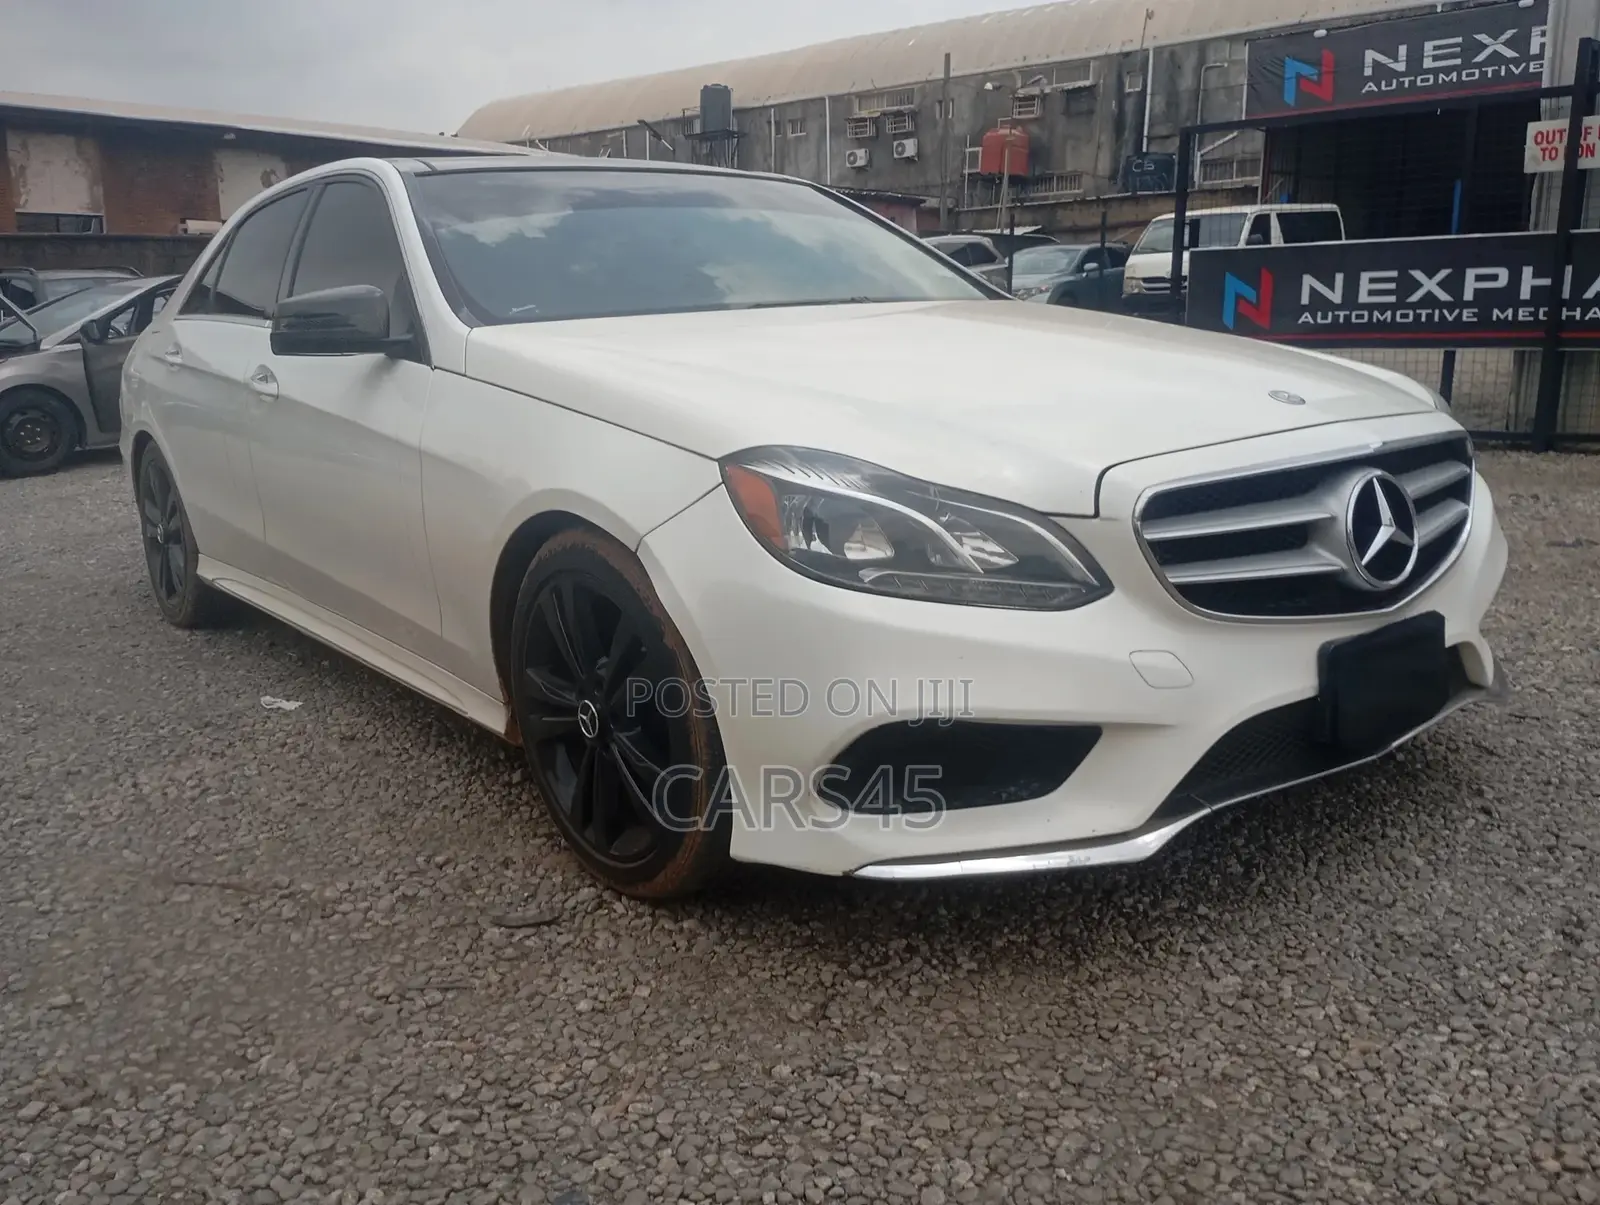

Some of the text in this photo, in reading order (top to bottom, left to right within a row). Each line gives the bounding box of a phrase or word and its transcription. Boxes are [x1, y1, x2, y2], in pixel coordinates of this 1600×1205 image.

[1361, 60, 1544, 94] AUTOMOTIVE
[1533, 127, 1567, 146] OUT
[1580, 126, 1594, 142] F
[1540, 146, 1559, 162] TO
[1297, 308, 1479, 325] AUTOMOTIVE
